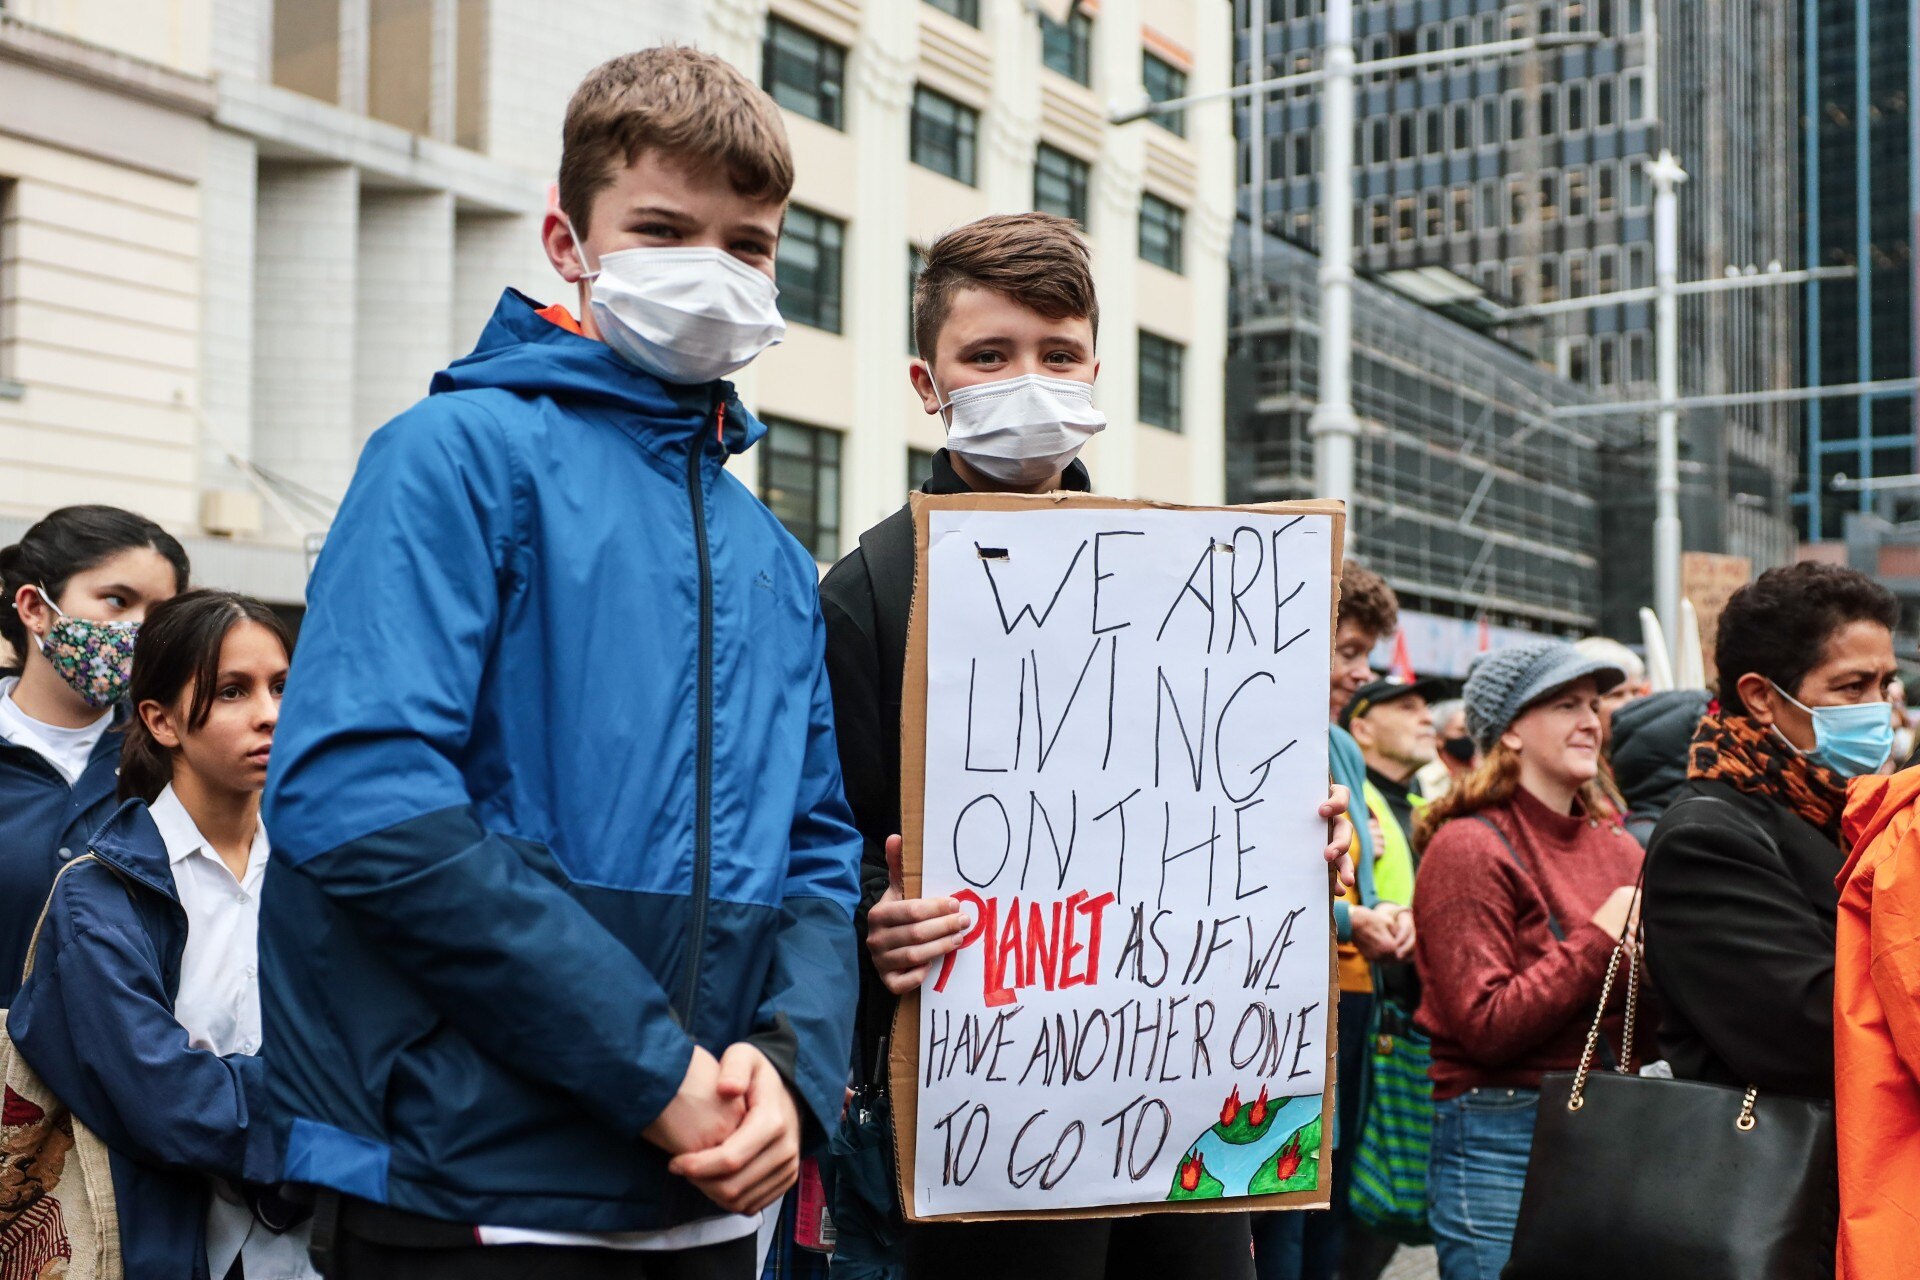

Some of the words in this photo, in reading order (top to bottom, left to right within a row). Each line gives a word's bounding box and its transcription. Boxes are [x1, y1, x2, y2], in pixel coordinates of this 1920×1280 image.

[975, 531, 1144, 634] WE
[1157, 516, 1310, 653] ARE
[965, 636, 1297, 803] LIVING
[954, 790, 1075, 890] ON
[1093, 789, 1268, 908] THE
[933, 888, 1115, 1007] PLANET
[1115, 901, 1172, 988] AS
[1182, 915, 1240, 985] IF
[1243, 907, 1306, 994] WE
[926, 1005, 1024, 1087] HAVE
[1018, 994, 1215, 1086] ANOTHER
[1229, 1001, 1319, 1081] ONE
[934, 1100, 990, 1186] TO
[1008, 1109, 1085, 1190] GO
[1102, 1095, 1171, 1184] TO
